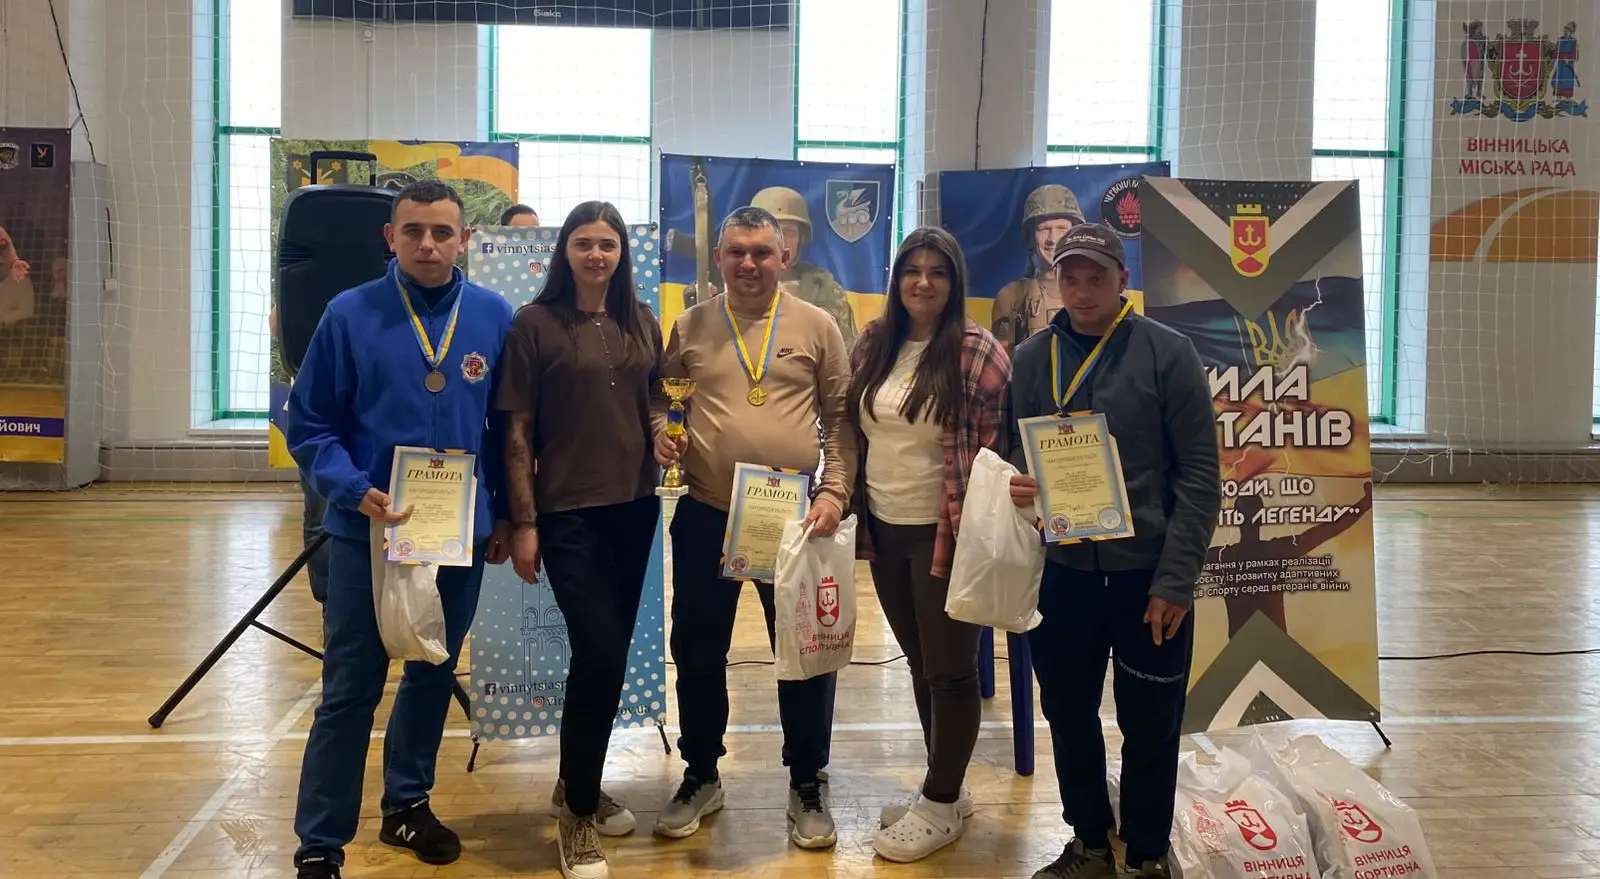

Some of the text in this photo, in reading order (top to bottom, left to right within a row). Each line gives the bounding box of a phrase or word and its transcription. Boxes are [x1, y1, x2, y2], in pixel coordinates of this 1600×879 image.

[1467, 138, 1569, 155] ВІННИЦЬКА
[1459, 159, 1576, 177] МІСЬКА РАДА
[1204, 366, 1308, 401] ИЛА
[1040, 434, 1100, 450] ГРАМОТА
[407, 469, 463, 481] ГРАМОТА
[747, 486, 798, 501] ГРАМОТА
[1281, 478, 1315, 495] ЩО
[1237, 560, 1244, 571] у
[1245, 559, 1280, 570] рамках
[1281, 555, 1332, 568] реалізації
[1235, 570, 1279, 583] розвитку
[1279, 569, 1339, 580] адаптивних
[1207, 585, 1239, 597] спорту
[1241, 583, 1270, 594] серед
[1271, 581, 1318, 593] ветеранів
[1320, 579, 1350, 591] війни
[1243, 856, 1305, 873] ВІННИЦЯ
[1354, 845, 1412, 867] ВІННИЦЯ
